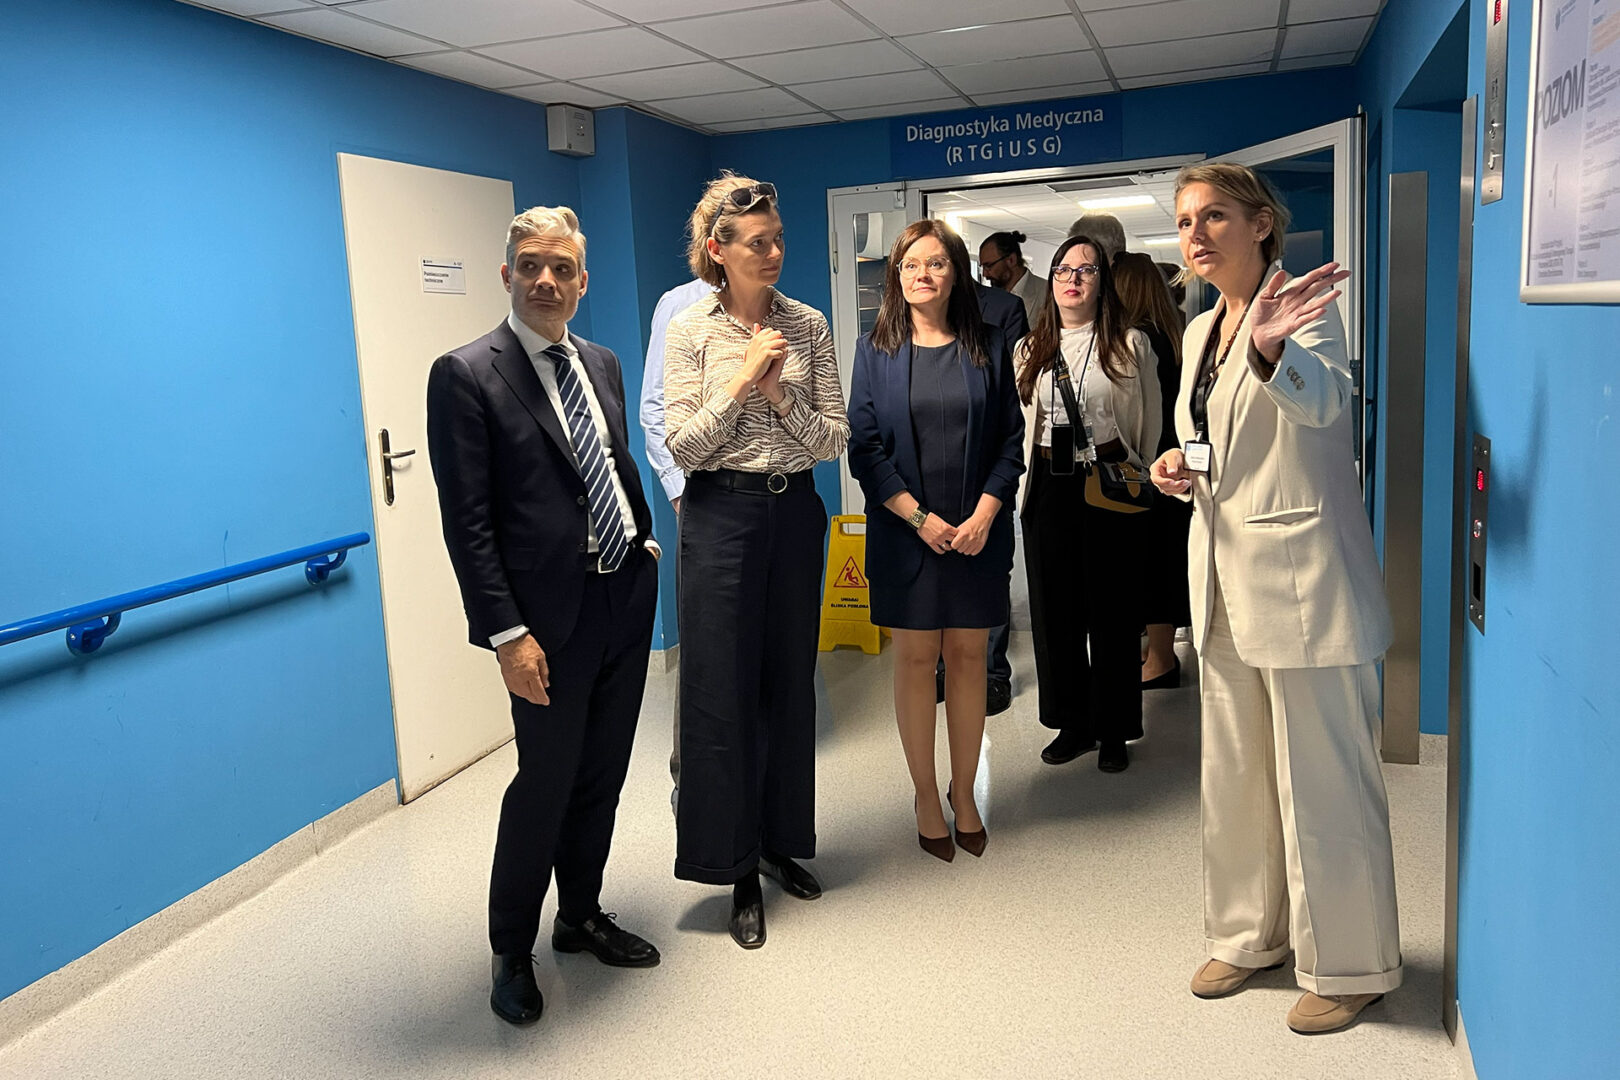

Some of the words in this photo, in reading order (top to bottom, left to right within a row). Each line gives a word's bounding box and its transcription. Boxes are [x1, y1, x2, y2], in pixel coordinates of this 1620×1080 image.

[1537, 58, 1587, 133] POZIOM
[907, 116, 1009, 143] Diagnostyka
[1016, 108, 1104, 131] Medyczna
